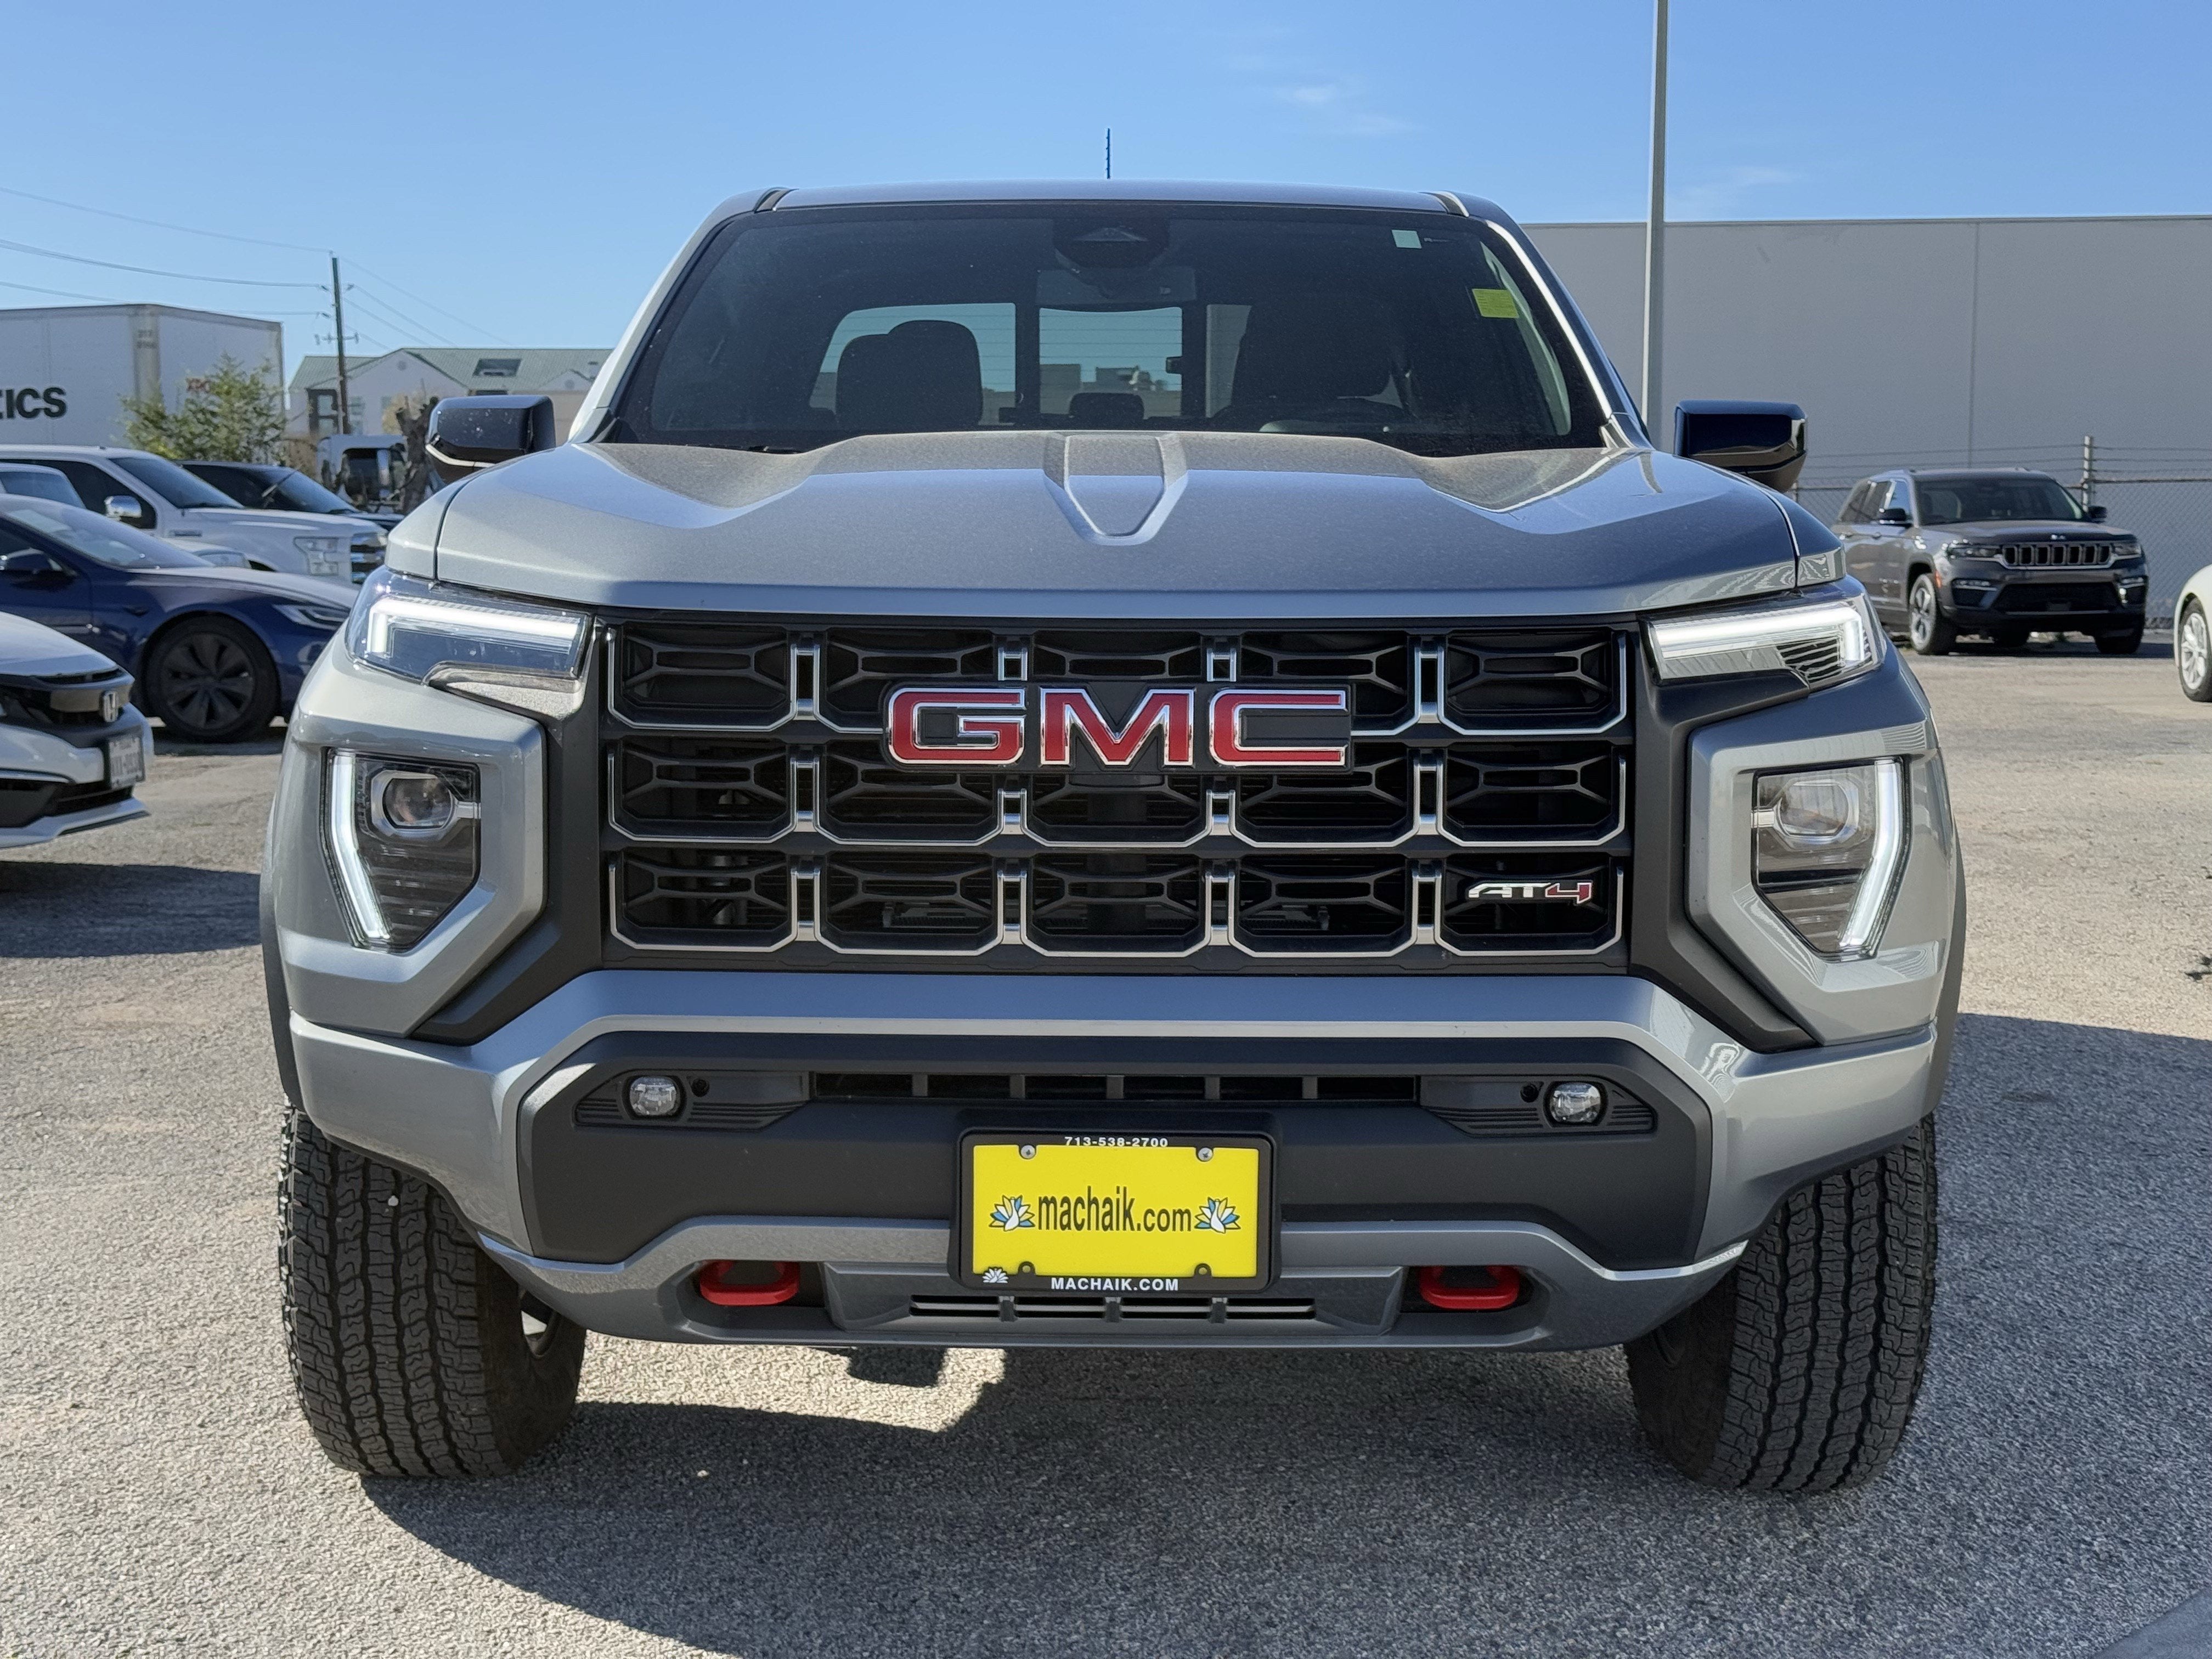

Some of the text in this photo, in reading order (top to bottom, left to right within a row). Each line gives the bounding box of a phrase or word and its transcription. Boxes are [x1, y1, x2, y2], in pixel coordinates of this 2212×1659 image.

[0, 387, 66, 418] ICS
[888, 686, 1350, 767] GMC
[1468, 882, 1593, 904] AT4
[1064, 1136, 1168, 1147] 713-538-2700
[1038, 1185, 1192, 1232] machaik.com
[1051, 1277, 1178, 1291] MACHAIK.COM
